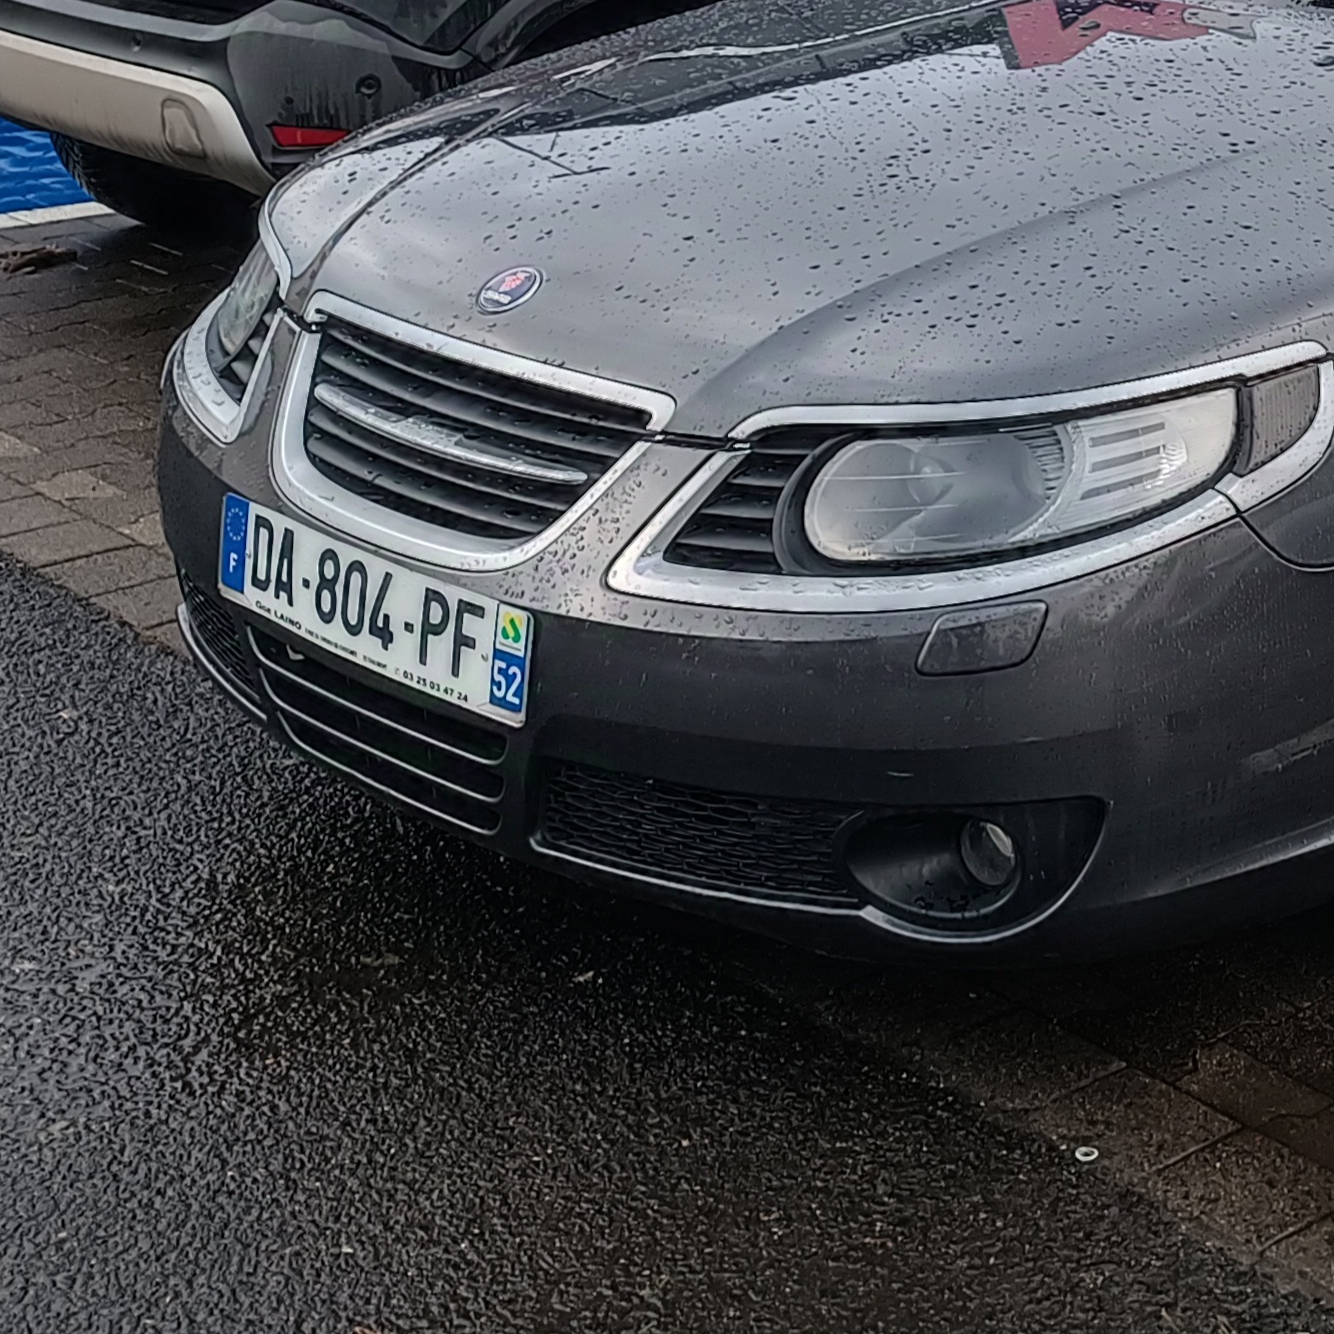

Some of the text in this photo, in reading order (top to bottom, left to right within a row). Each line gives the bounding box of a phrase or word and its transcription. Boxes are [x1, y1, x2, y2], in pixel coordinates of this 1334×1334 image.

[229, 552, 239, 573] F
[250, 513, 486, 679] DA-804-PF
[457, 690, 468, 703] 24
[492, 658, 522, 705] 52
